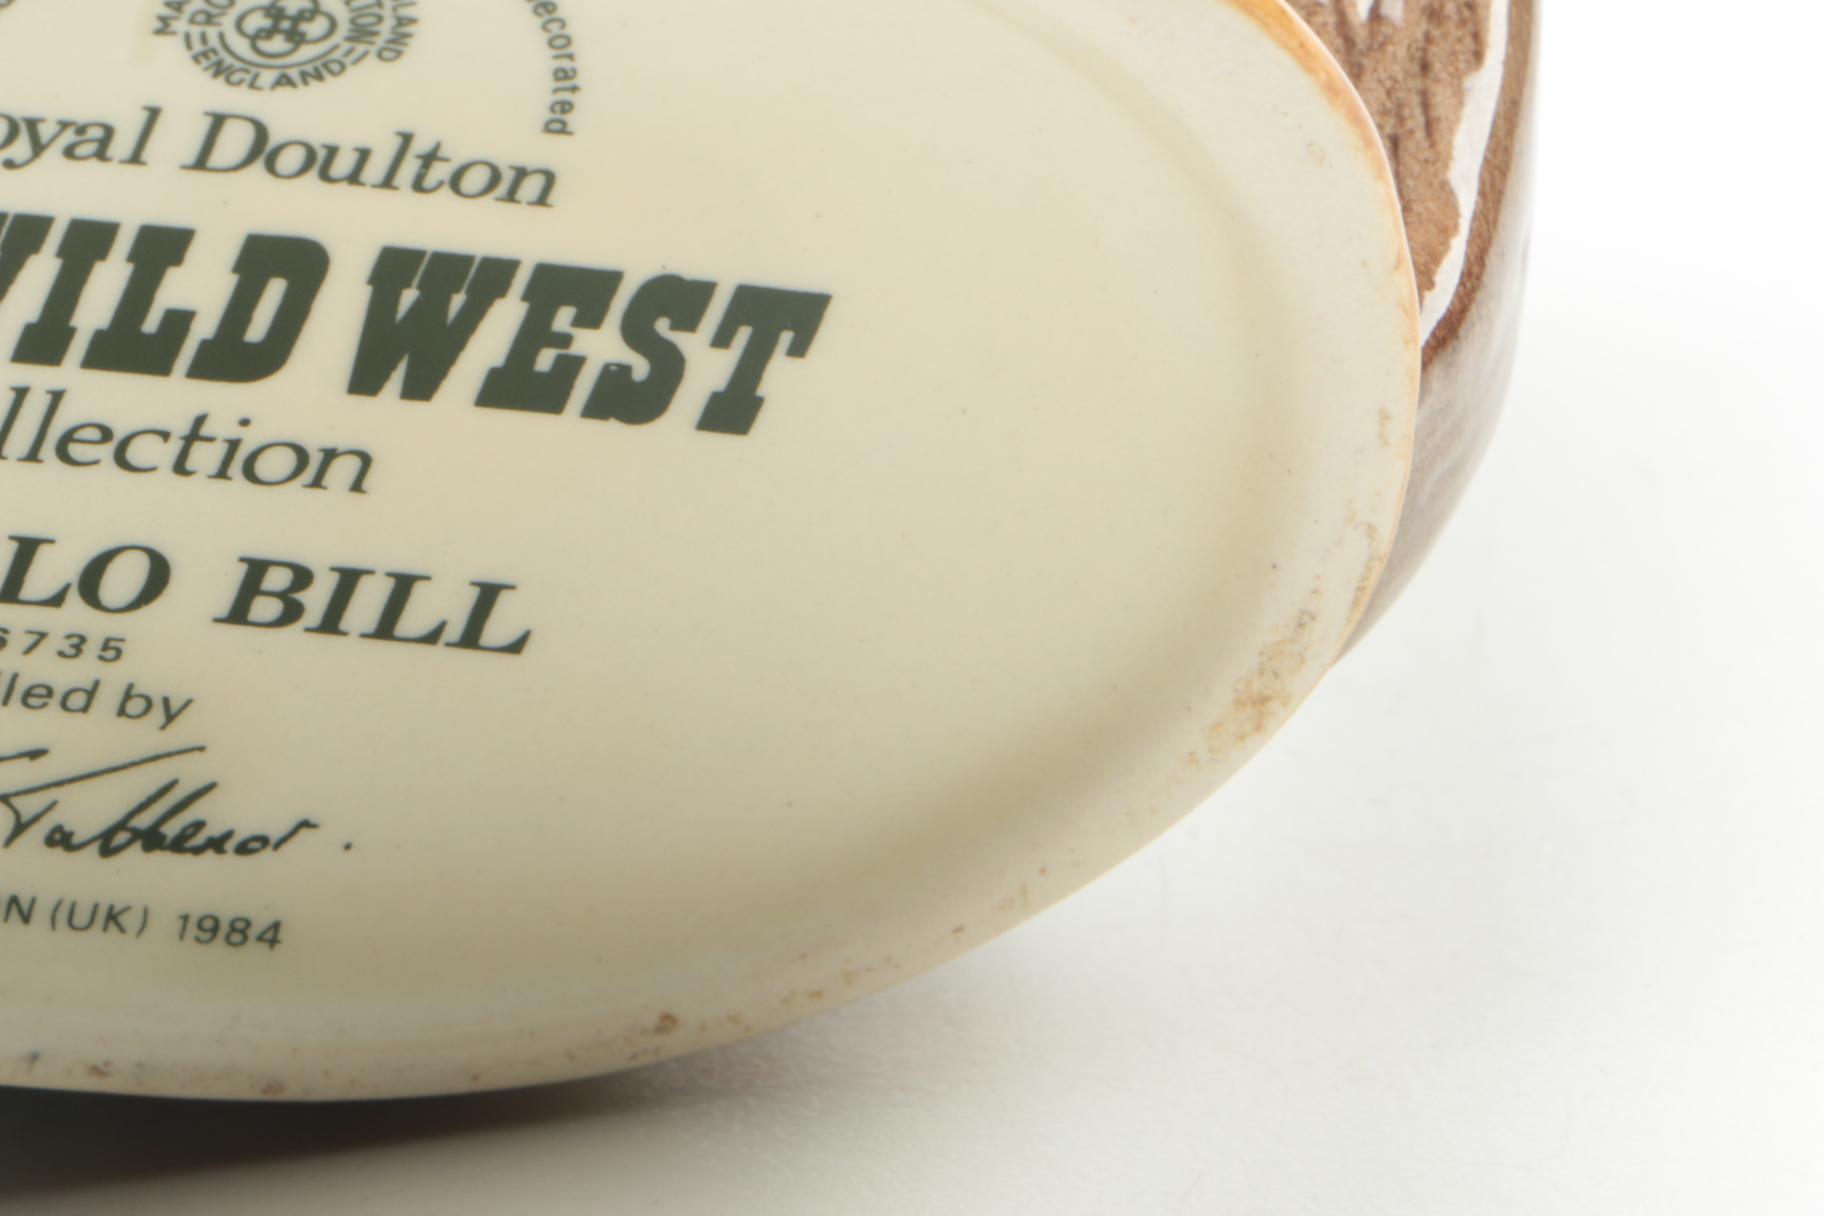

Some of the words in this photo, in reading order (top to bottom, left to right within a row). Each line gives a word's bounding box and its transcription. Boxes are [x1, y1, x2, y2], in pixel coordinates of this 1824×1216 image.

[191, 46, 348, 90] ENGLAND
[180, 111, 559, 208] Doulton
[346, 245, 833, 437] WEST
[211, 556, 532, 656] BILL
[115, 682, 194, 731] by
[177, 913, 283, 951] 1984
